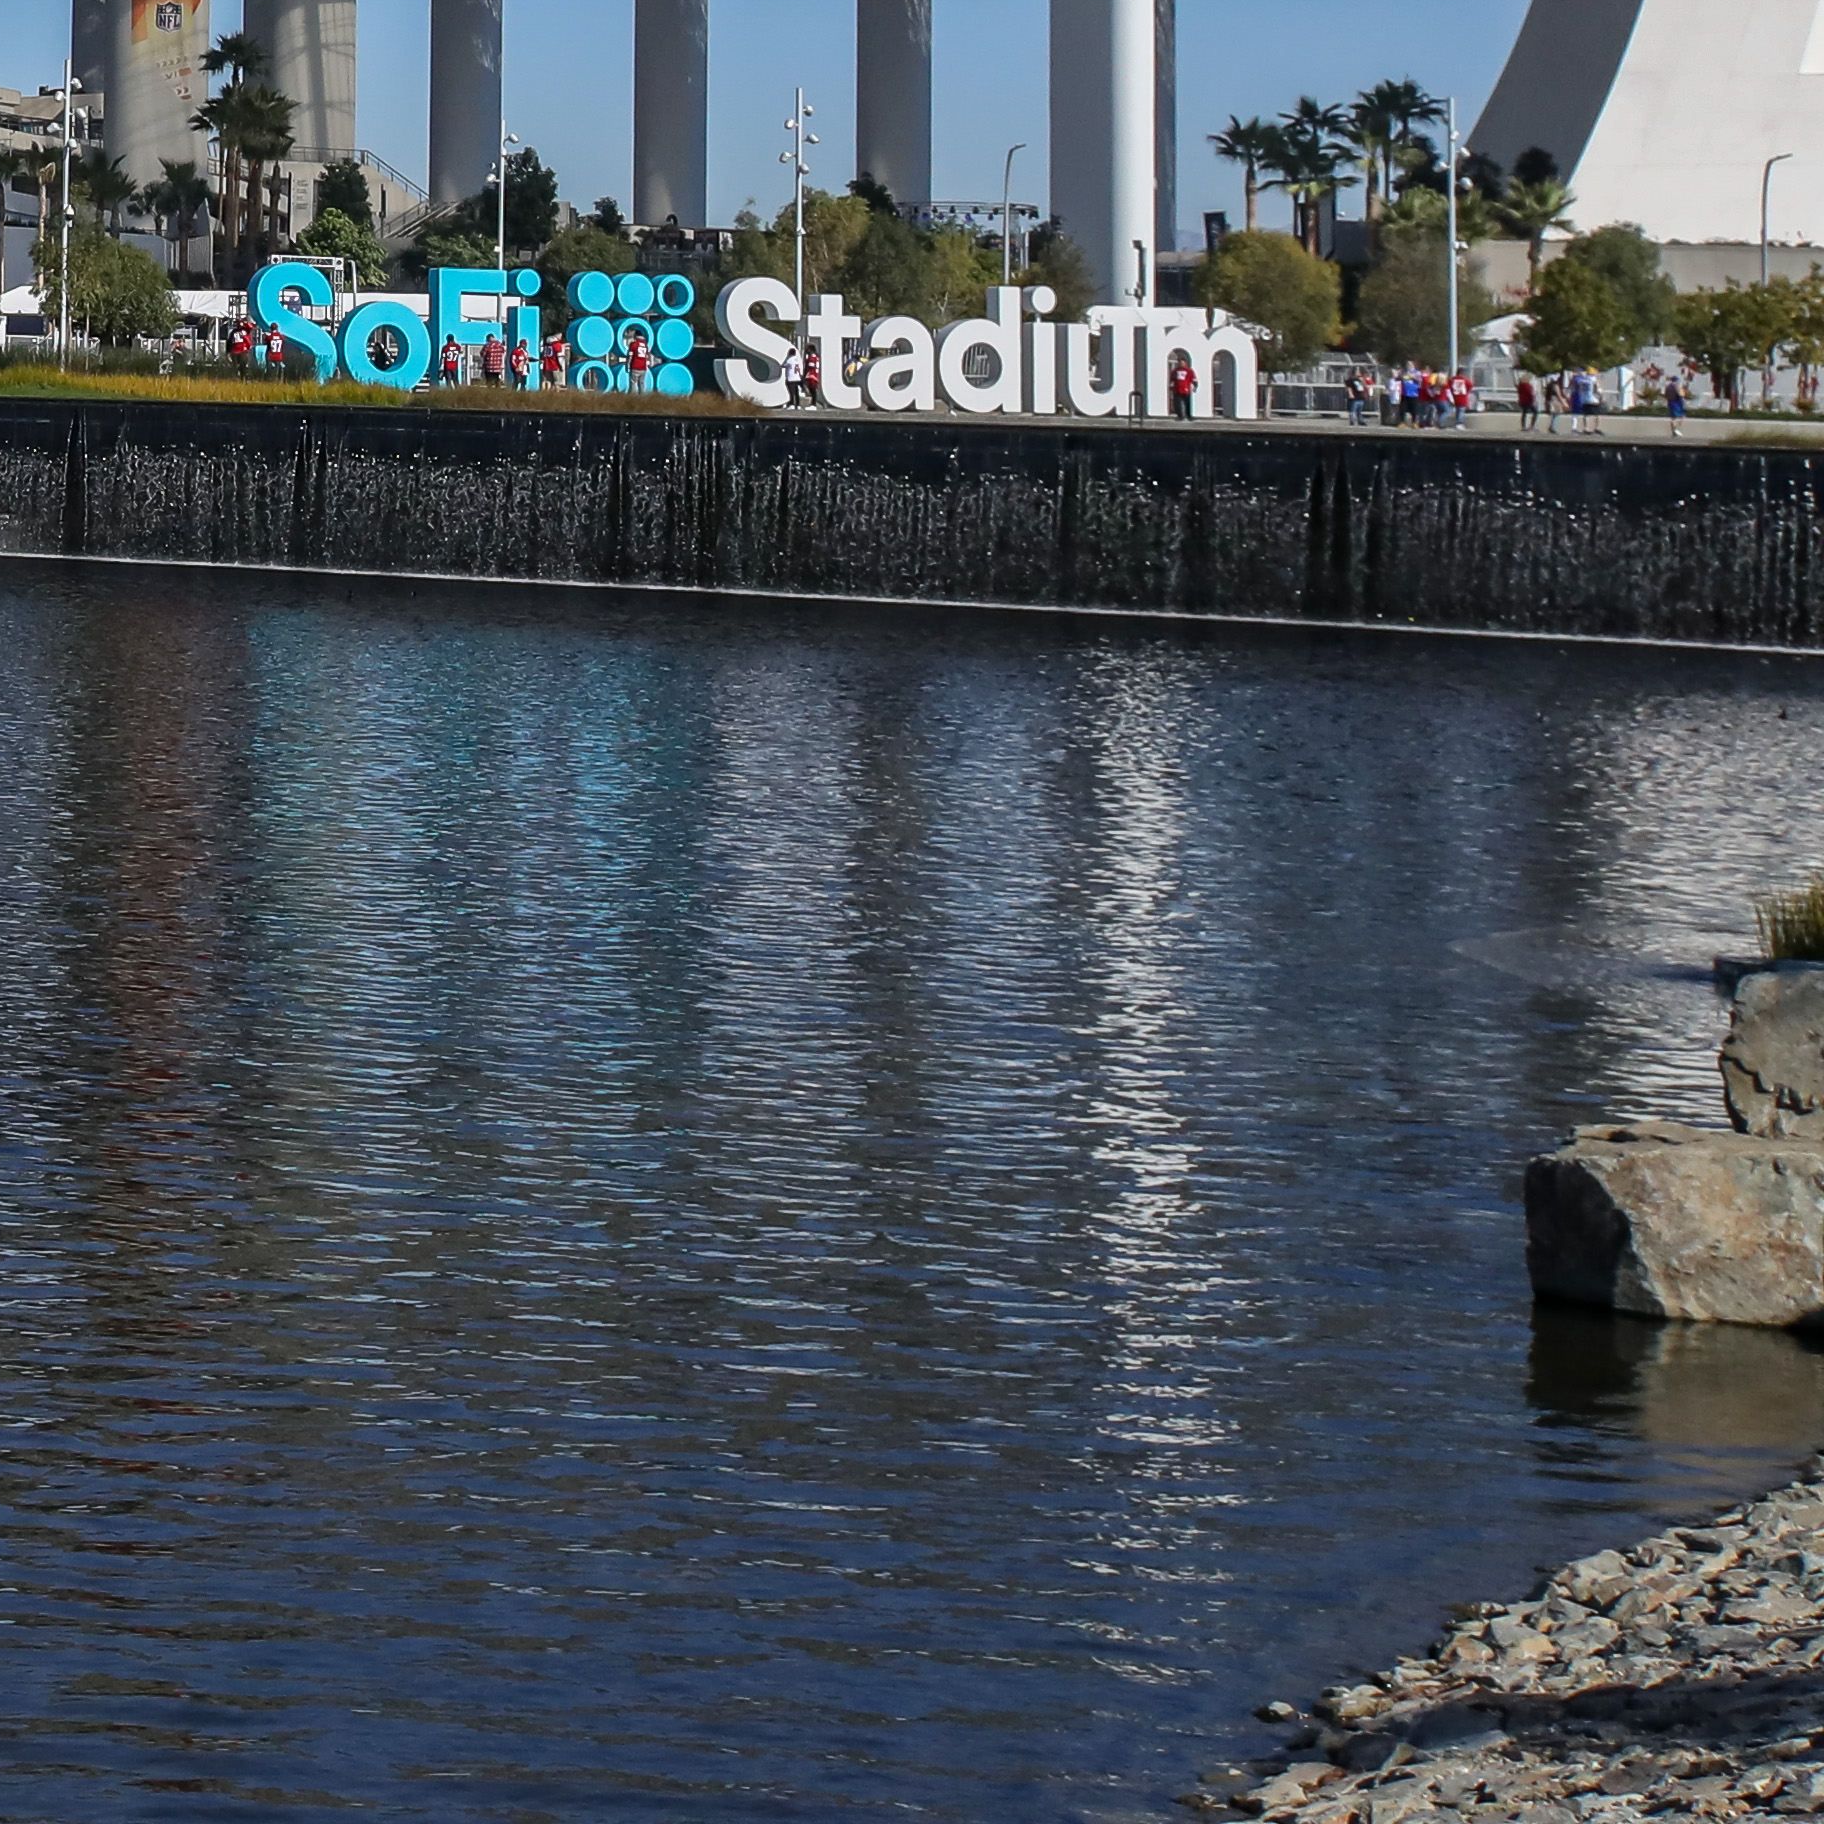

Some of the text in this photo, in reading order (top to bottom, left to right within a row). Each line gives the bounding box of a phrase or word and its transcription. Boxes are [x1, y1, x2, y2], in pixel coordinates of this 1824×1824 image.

[159, 14, 180, 29] NFL
[248, 261, 541, 392] SoFi
[271, 339, 283, 353] 97
[714, 277, 1259, 420] Stadium
[447, 350, 459, 362] 97
